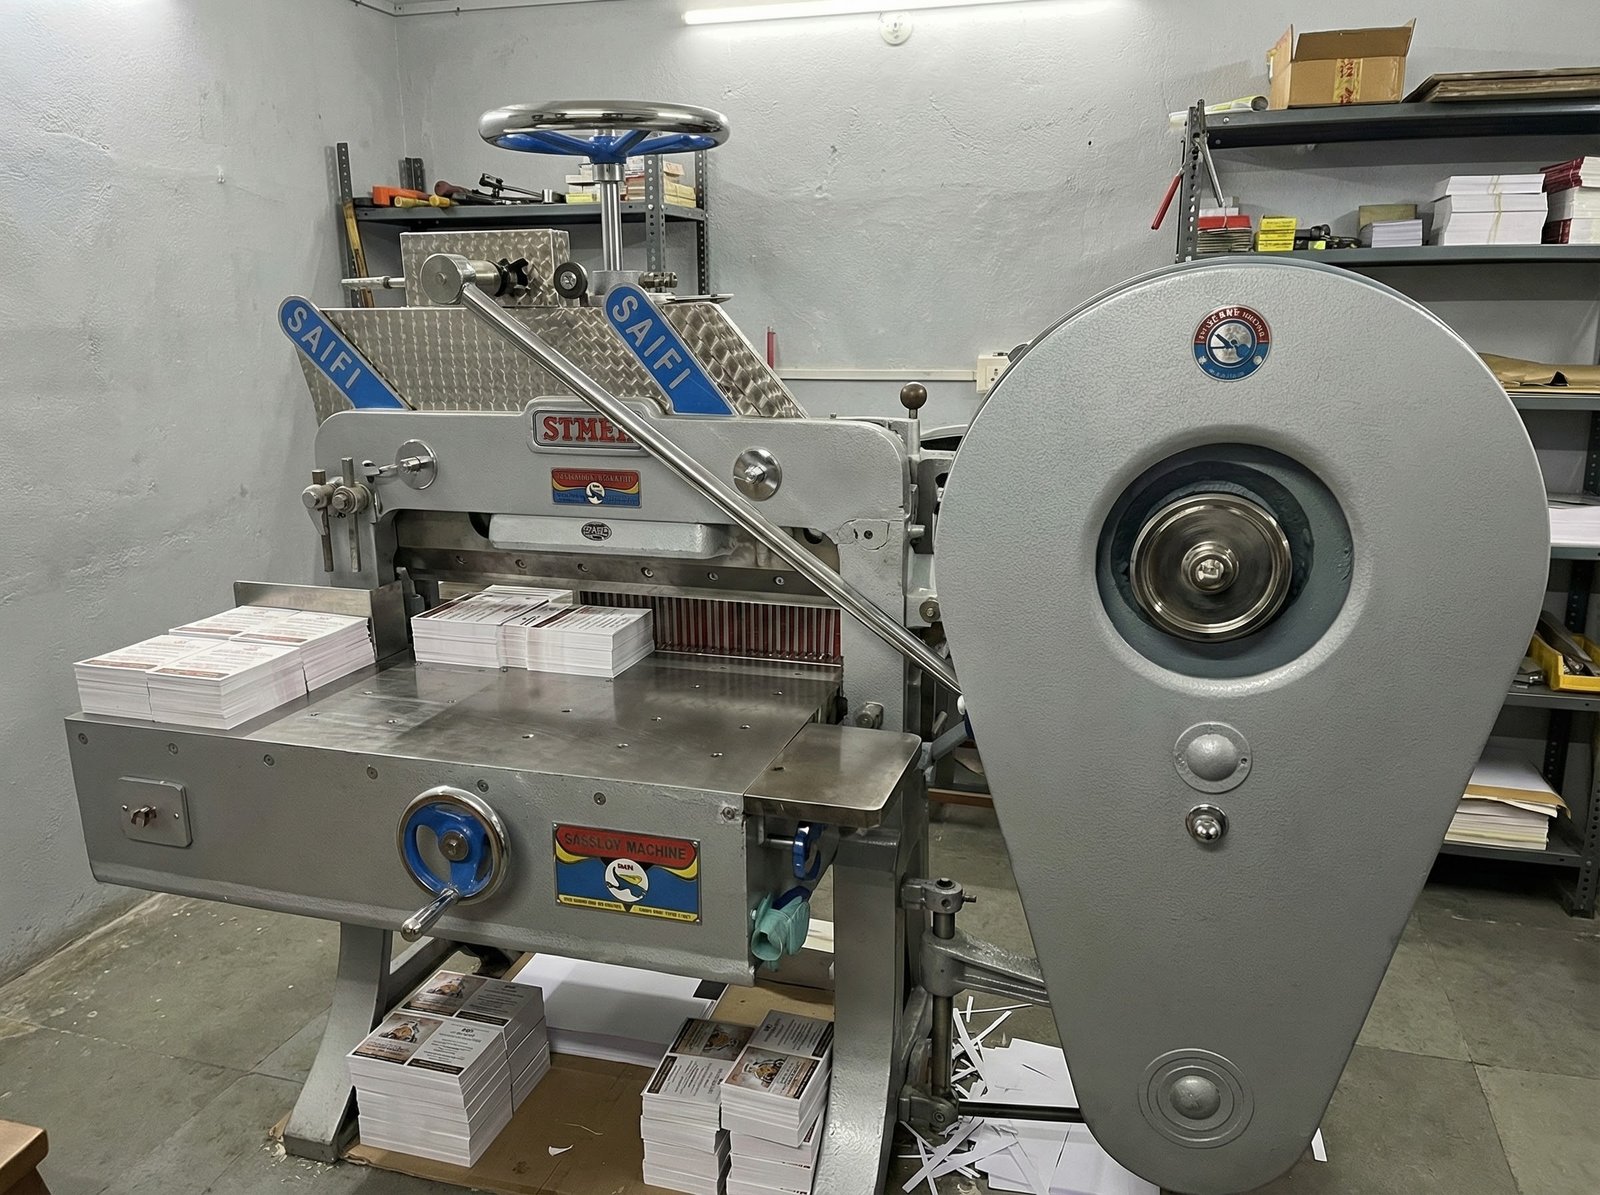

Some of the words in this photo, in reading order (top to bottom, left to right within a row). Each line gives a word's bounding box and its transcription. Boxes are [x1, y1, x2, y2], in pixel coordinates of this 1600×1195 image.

[287, 306, 361, 389] SAIFI
[612, 295, 691, 389] SAIFI
[627, 841, 686, 860] MACHINE
